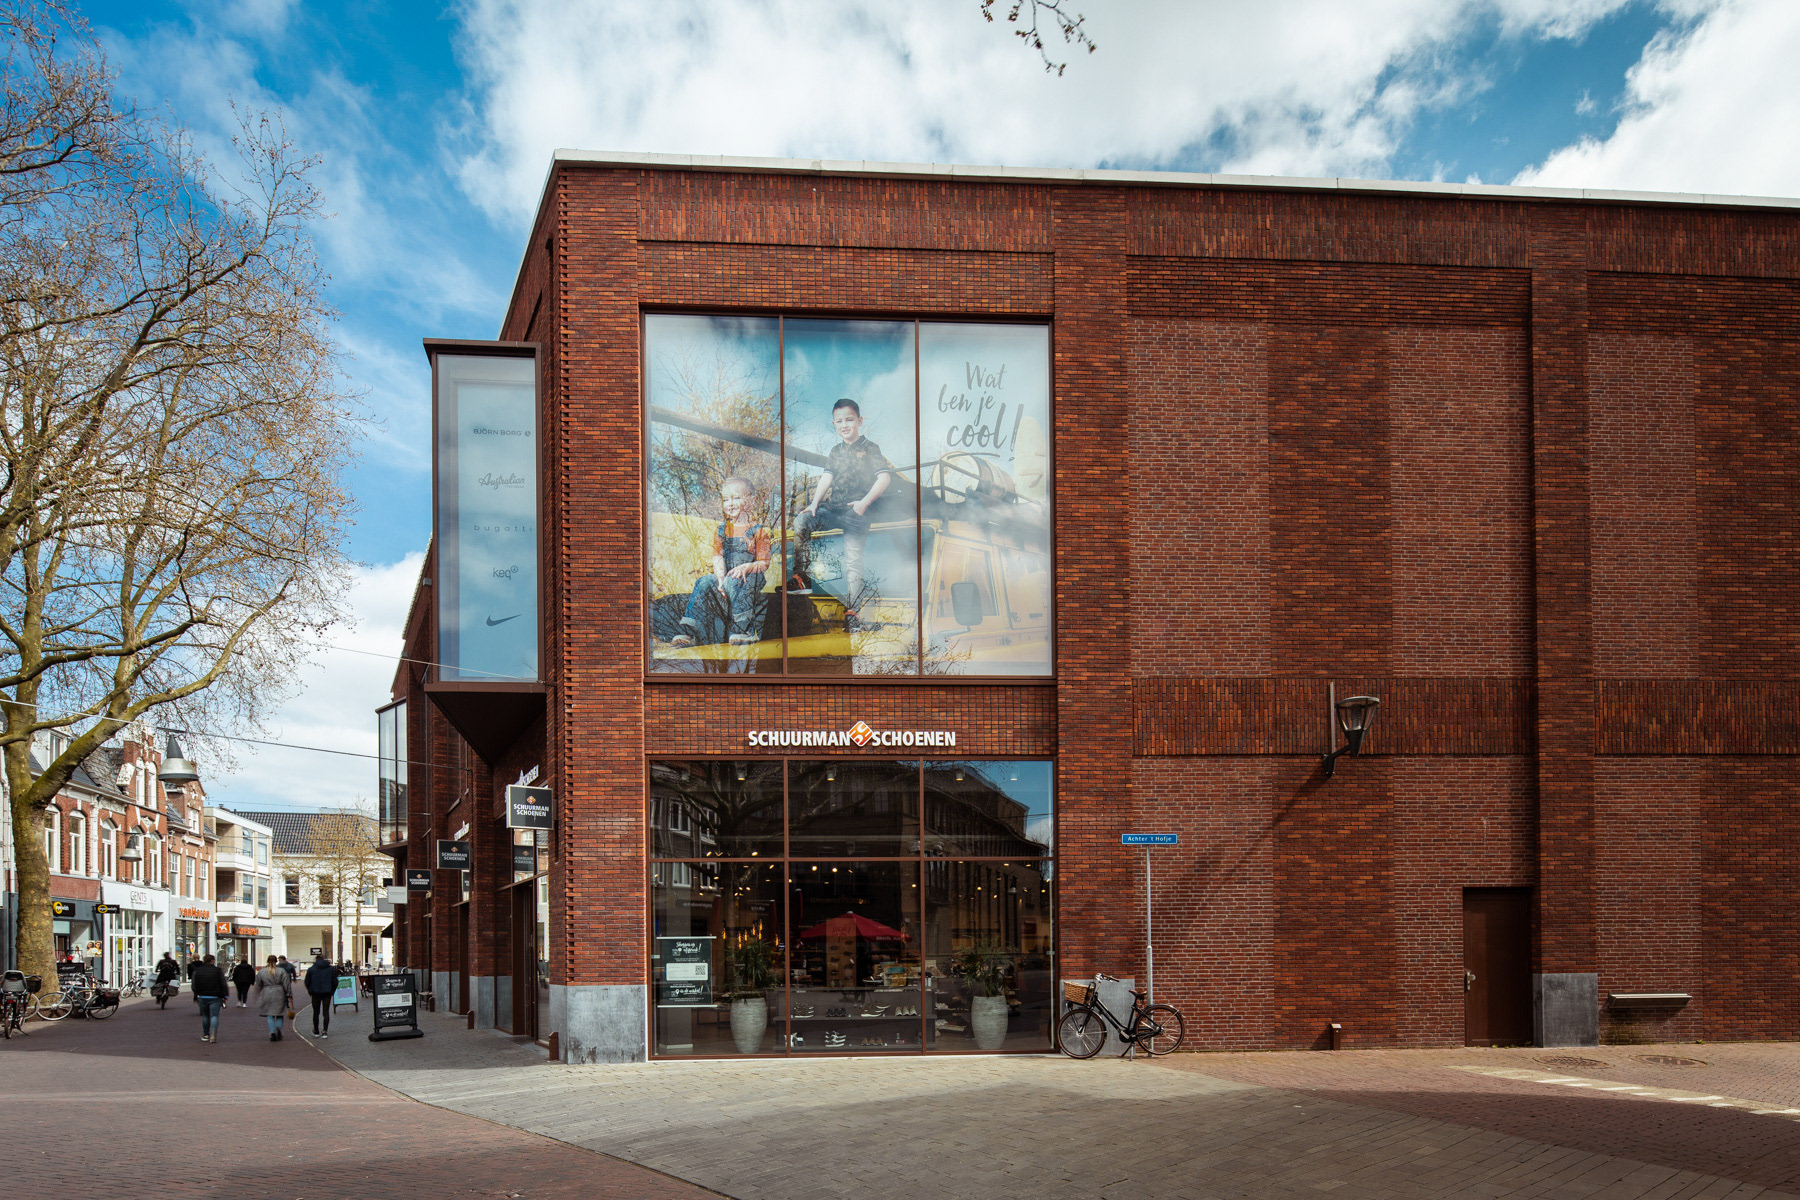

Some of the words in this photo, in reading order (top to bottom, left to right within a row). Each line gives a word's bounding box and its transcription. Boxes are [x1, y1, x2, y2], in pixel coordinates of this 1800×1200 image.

[966, 361, 1007, 390] Wat
[938, 383, 972, 413] ben
[973, 390, 996, 427] je
[473, 427, 499, 435] BJÖRN
[946, 402, 1024, 461] cool!
[478, 472, 525, 490] Australian
[474, 524, 533, 533] bugatti
[492, 567, 511, 581] keq
[748, 730, 850, 747] SCHUURMAN
[871, 730, 956, 747] SCHOENEN
[513, 803, 550, 812] SCHUURMAN
[516, 809, 547, 817] SCHOENEN
[130, 890, 147, 902] GENTS
